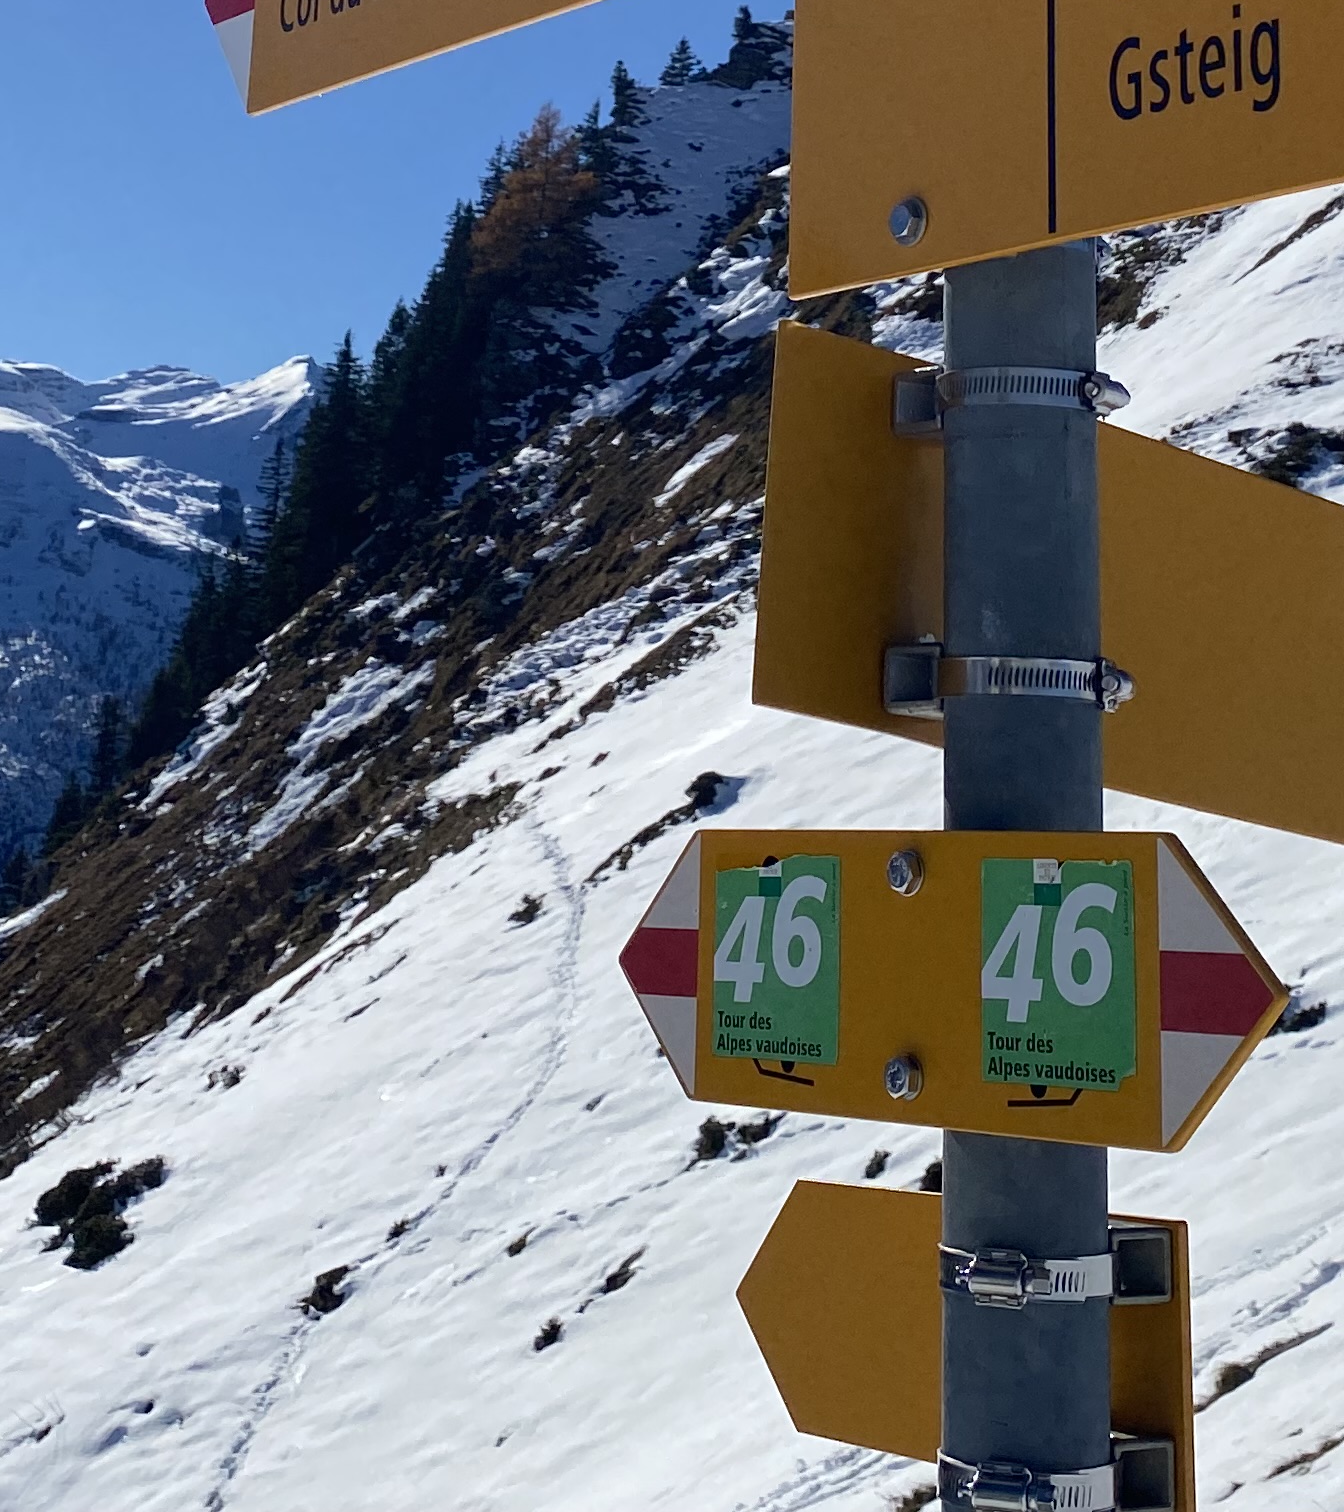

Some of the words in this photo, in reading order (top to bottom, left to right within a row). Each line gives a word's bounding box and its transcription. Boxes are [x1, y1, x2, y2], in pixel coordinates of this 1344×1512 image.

[1108, 2, 1284, 123] Gsteig
[713, 874, 828, 1004] 46
[980, 881, 1119, 1024] 46
[717, 1010, 746, 1030] Tour
[749, 1011, 773, 1031] des
[716, 1032, 753, 1056] Alpes
[756, 1036, 823, 1059] vaudoises
[987, 1031, 1023, 1053] Tour
[1026, 1032, 1054, 1054] des
[987, 1056, 1031, 1082] Alpes
[1035, 1061, 1117, 1085] vaudoises
